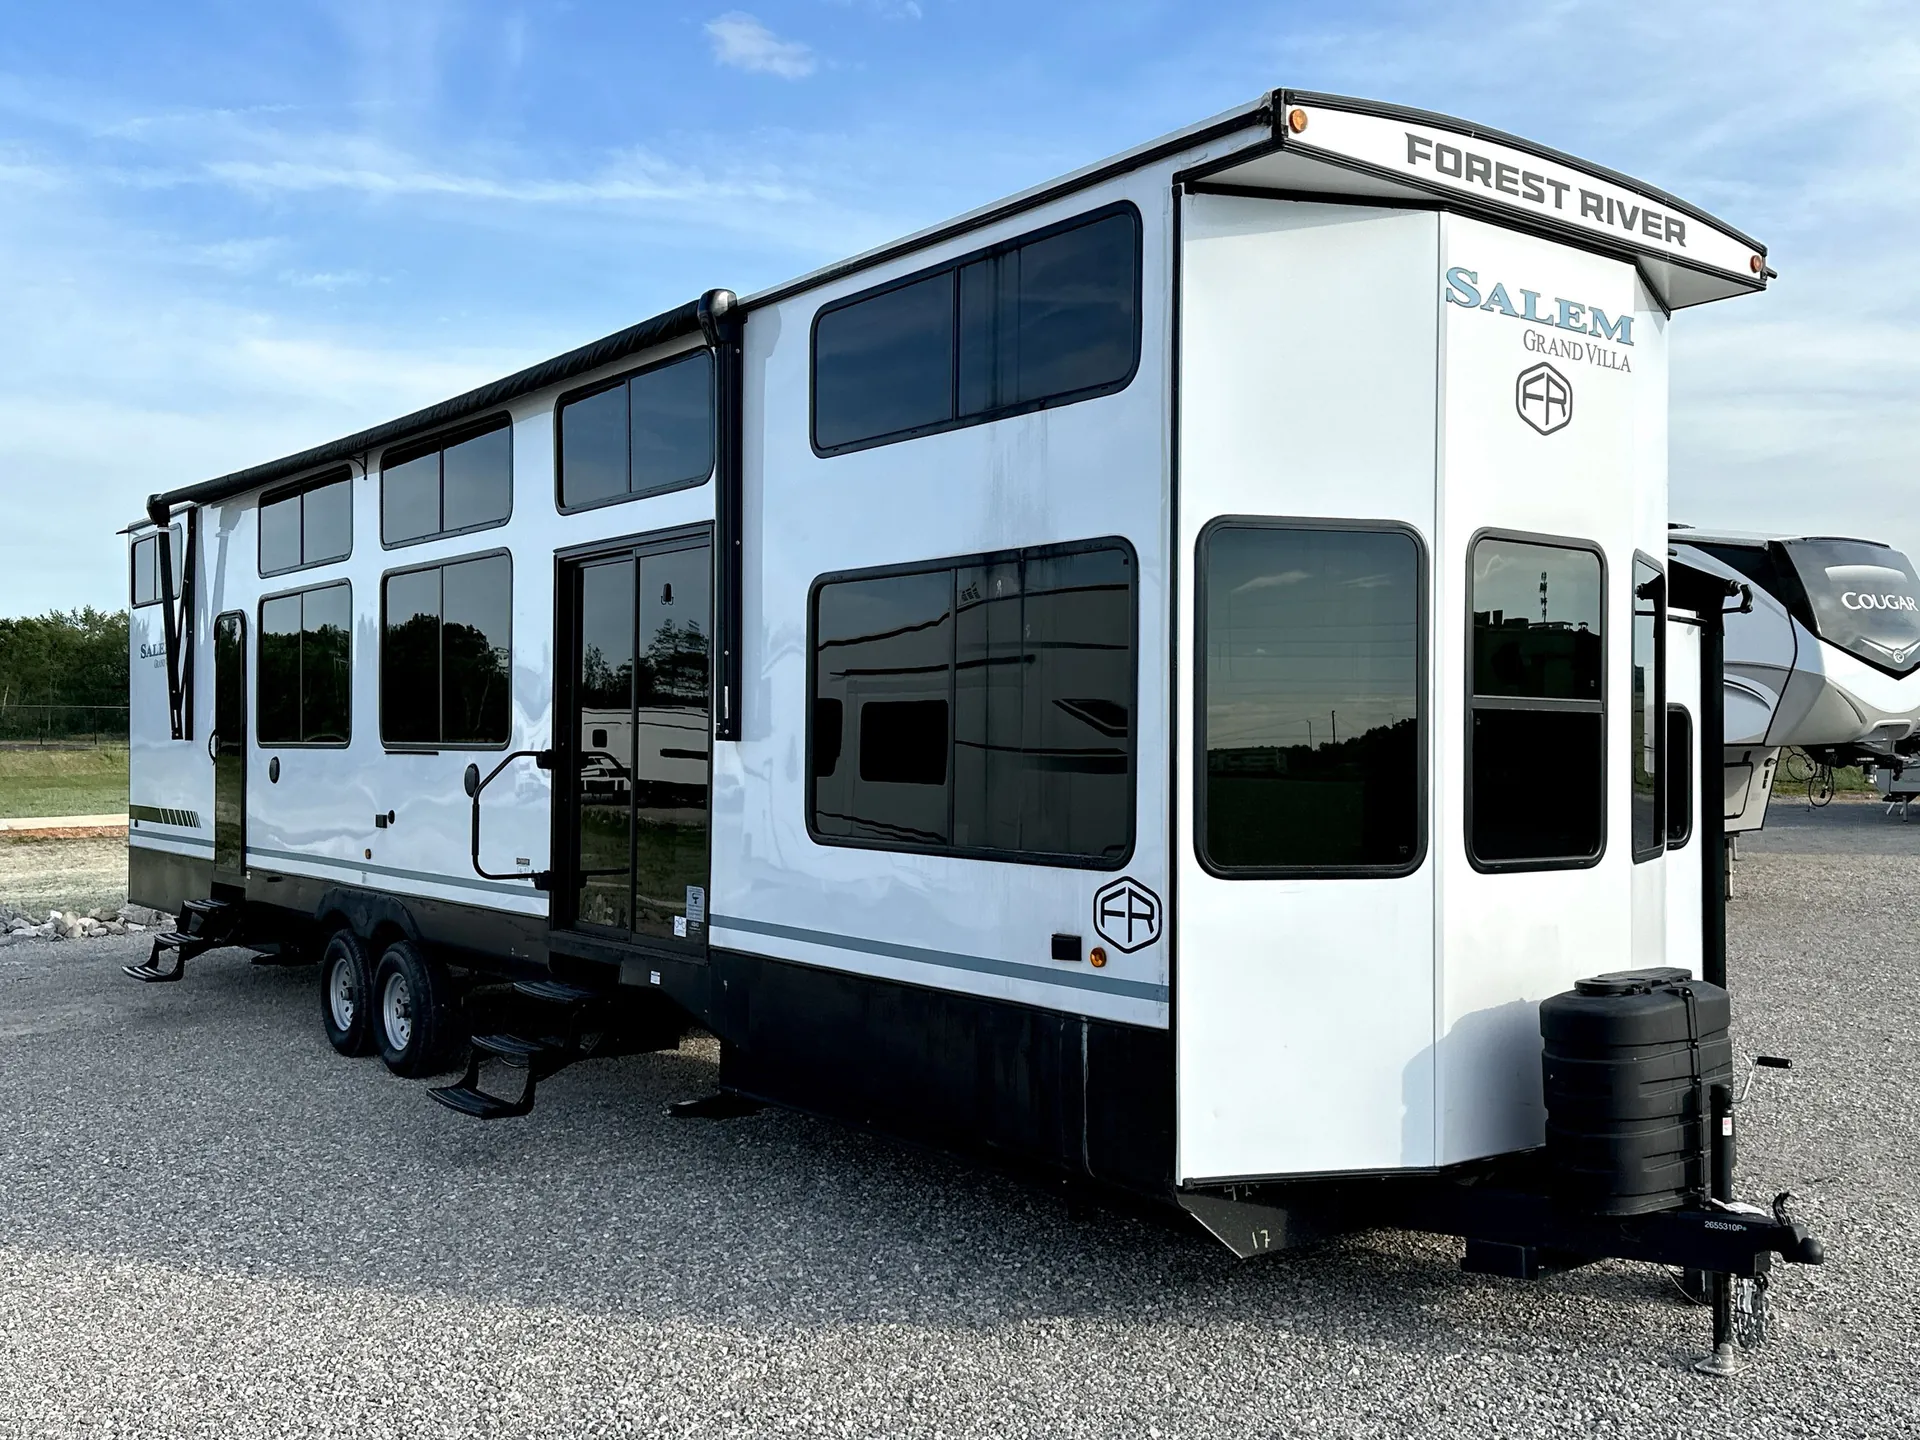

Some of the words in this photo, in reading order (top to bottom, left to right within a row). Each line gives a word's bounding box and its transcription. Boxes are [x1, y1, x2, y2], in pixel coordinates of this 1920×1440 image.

[1404, 132, 1571, 209] FOREST
[1579, 187, 1687, 248] RIVER
[1445, 265, 1635, 347] SALEM
[1522, 328, 1584, 362] GRAND
[1585, 342, 1632, 373] VILLA
[1522, 371, 1568, 426] FR
[1841, 591, 1919, 612] COUGAR
[140, 642, 167, 659] SALE
[1100, 886, 1155, 943] FR
[1251, 1229, 1271, 1250] 17
[1704, 1220, 1743, 1231] 2655310P
